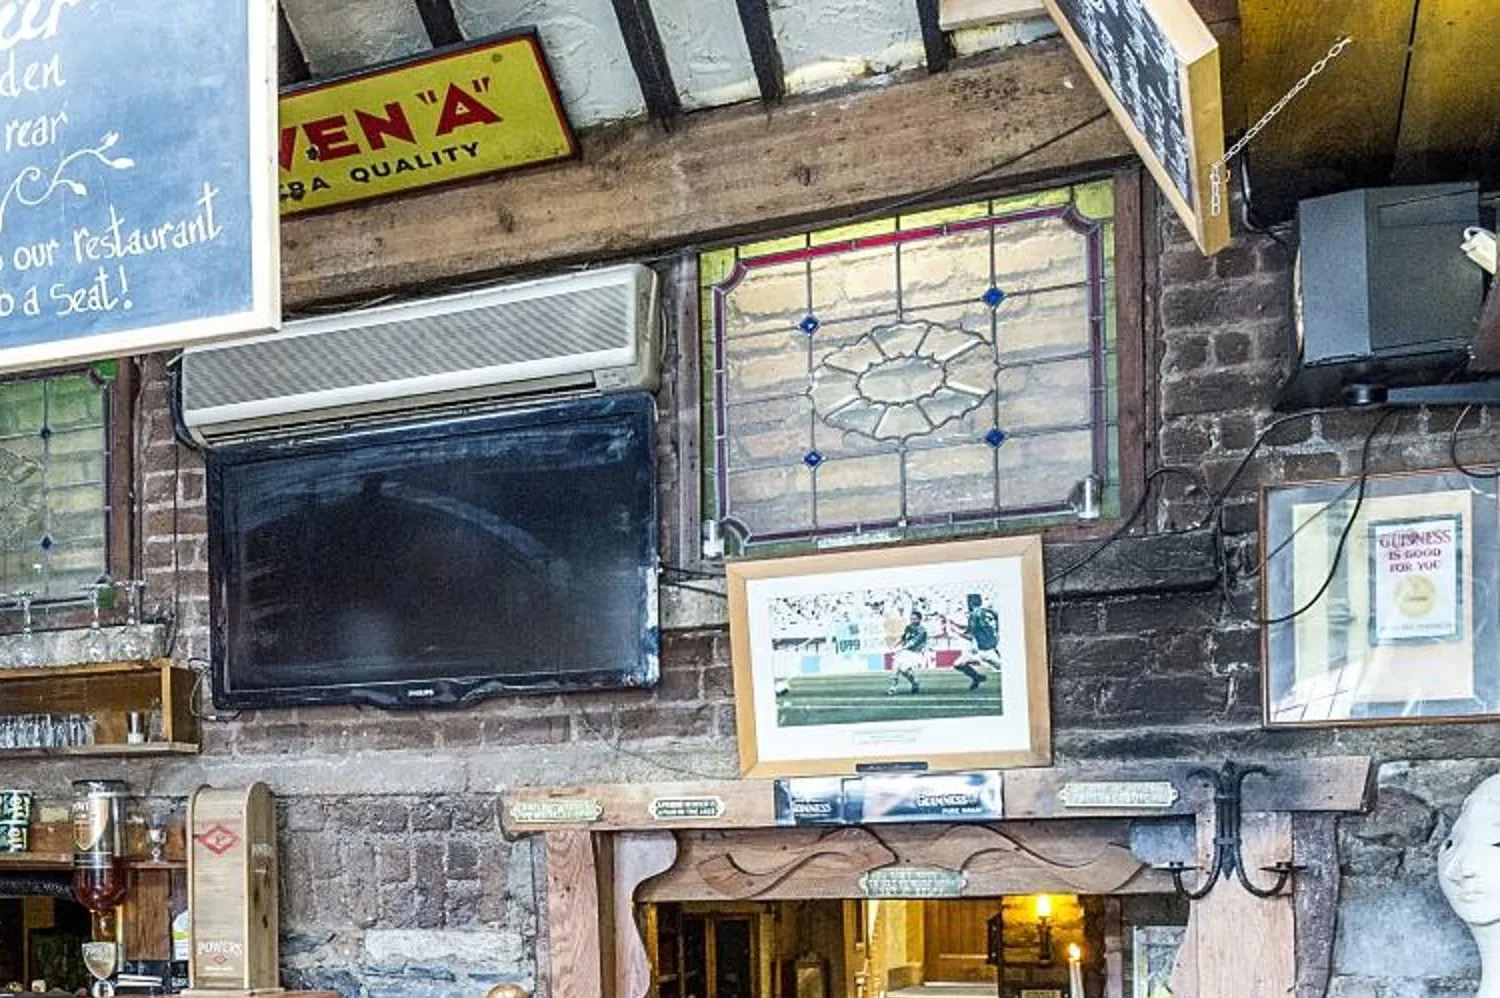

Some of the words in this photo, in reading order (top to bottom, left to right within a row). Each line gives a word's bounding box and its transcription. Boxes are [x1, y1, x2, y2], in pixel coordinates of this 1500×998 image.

[5, 110, 69, 152] rear
[350, 141, 480, 184] QUALITY
[13, 240, 59, 271] our
[73, 187, 224, 264] restaurant
[23, 297, 41, 316] a
[197, 939, 245, 958] POWERS
